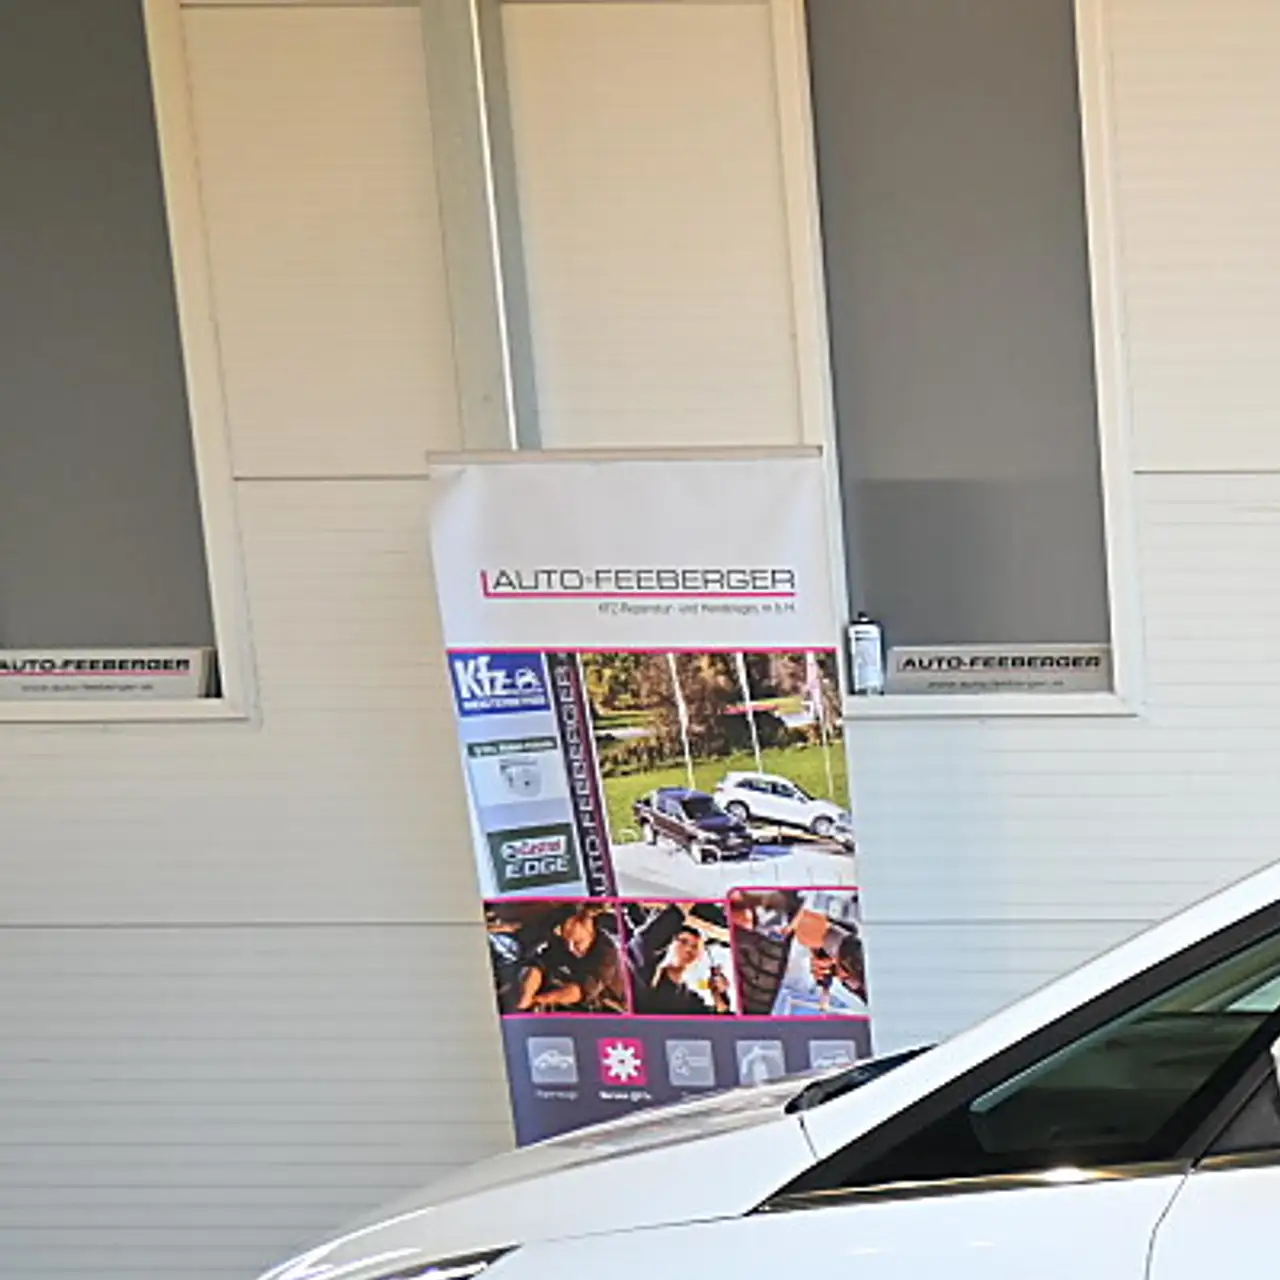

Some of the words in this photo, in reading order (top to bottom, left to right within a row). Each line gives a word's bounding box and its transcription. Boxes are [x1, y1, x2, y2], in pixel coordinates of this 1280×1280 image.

[493, 569, 796, 590] AUTO-FEEBERGER
[902, 656, 1101, 670] AUTO-FEEBERGER
[554, 666, 608, 897] UTO-FEEBERGER
[505, 857, 570, 878] EDGE
